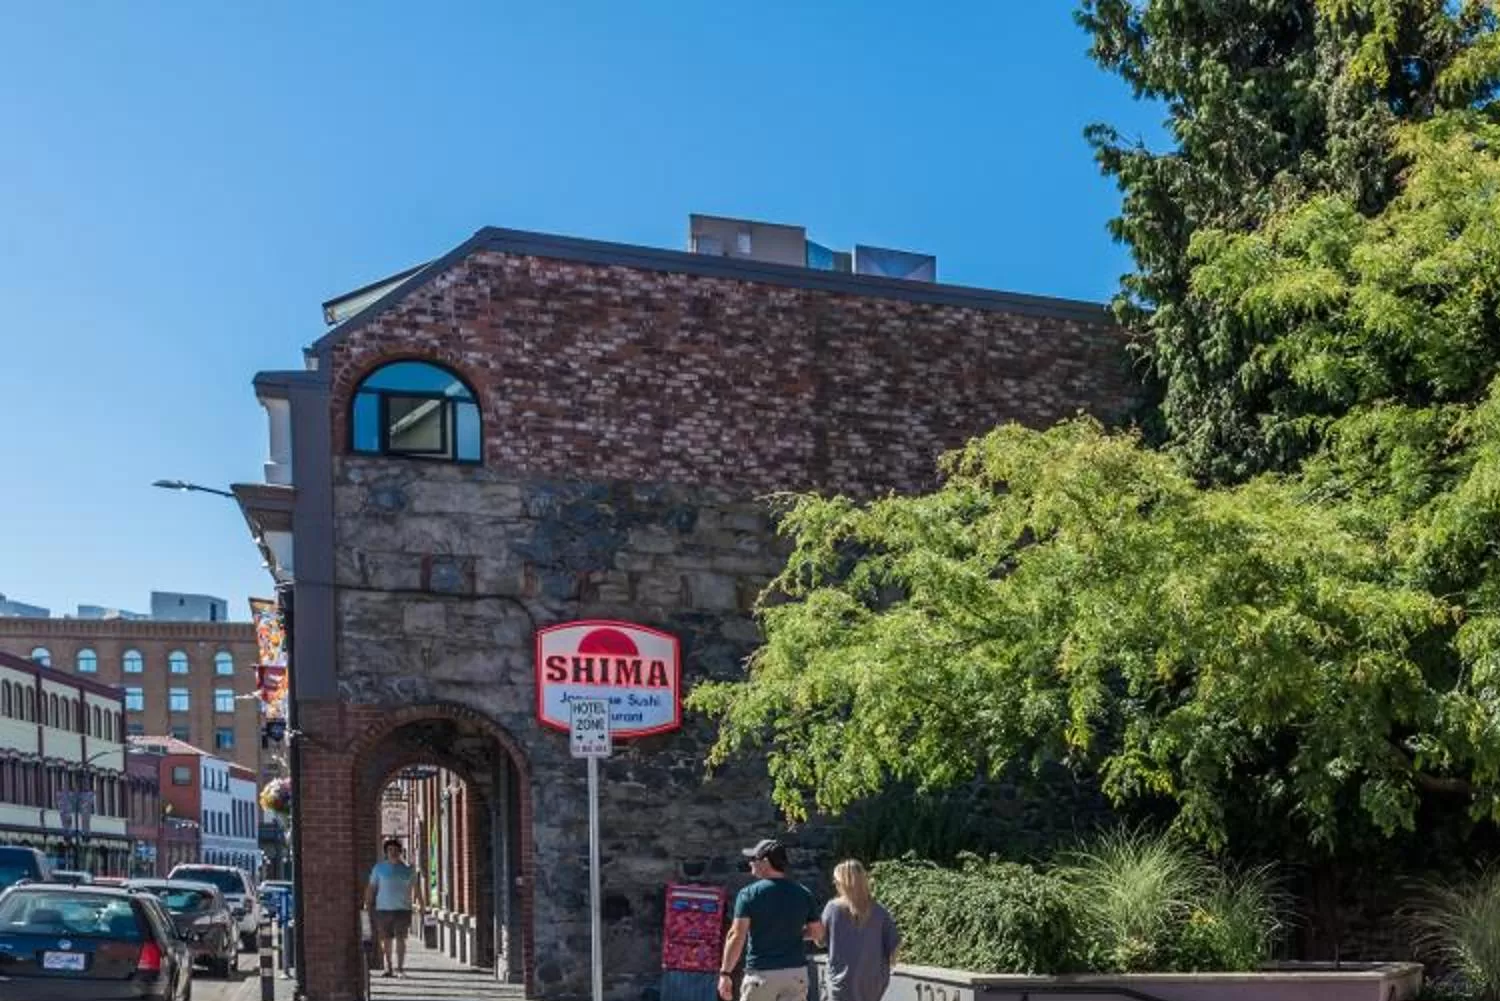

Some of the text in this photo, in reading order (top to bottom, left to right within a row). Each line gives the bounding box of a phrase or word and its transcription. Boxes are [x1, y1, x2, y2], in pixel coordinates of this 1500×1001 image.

[545, 655, 670, 688] SHIMA
[573, 701, 606, 714] HOTEL
[627, 693, 662, 708] Sushi
[576, 718, 605, 731] ZONE
